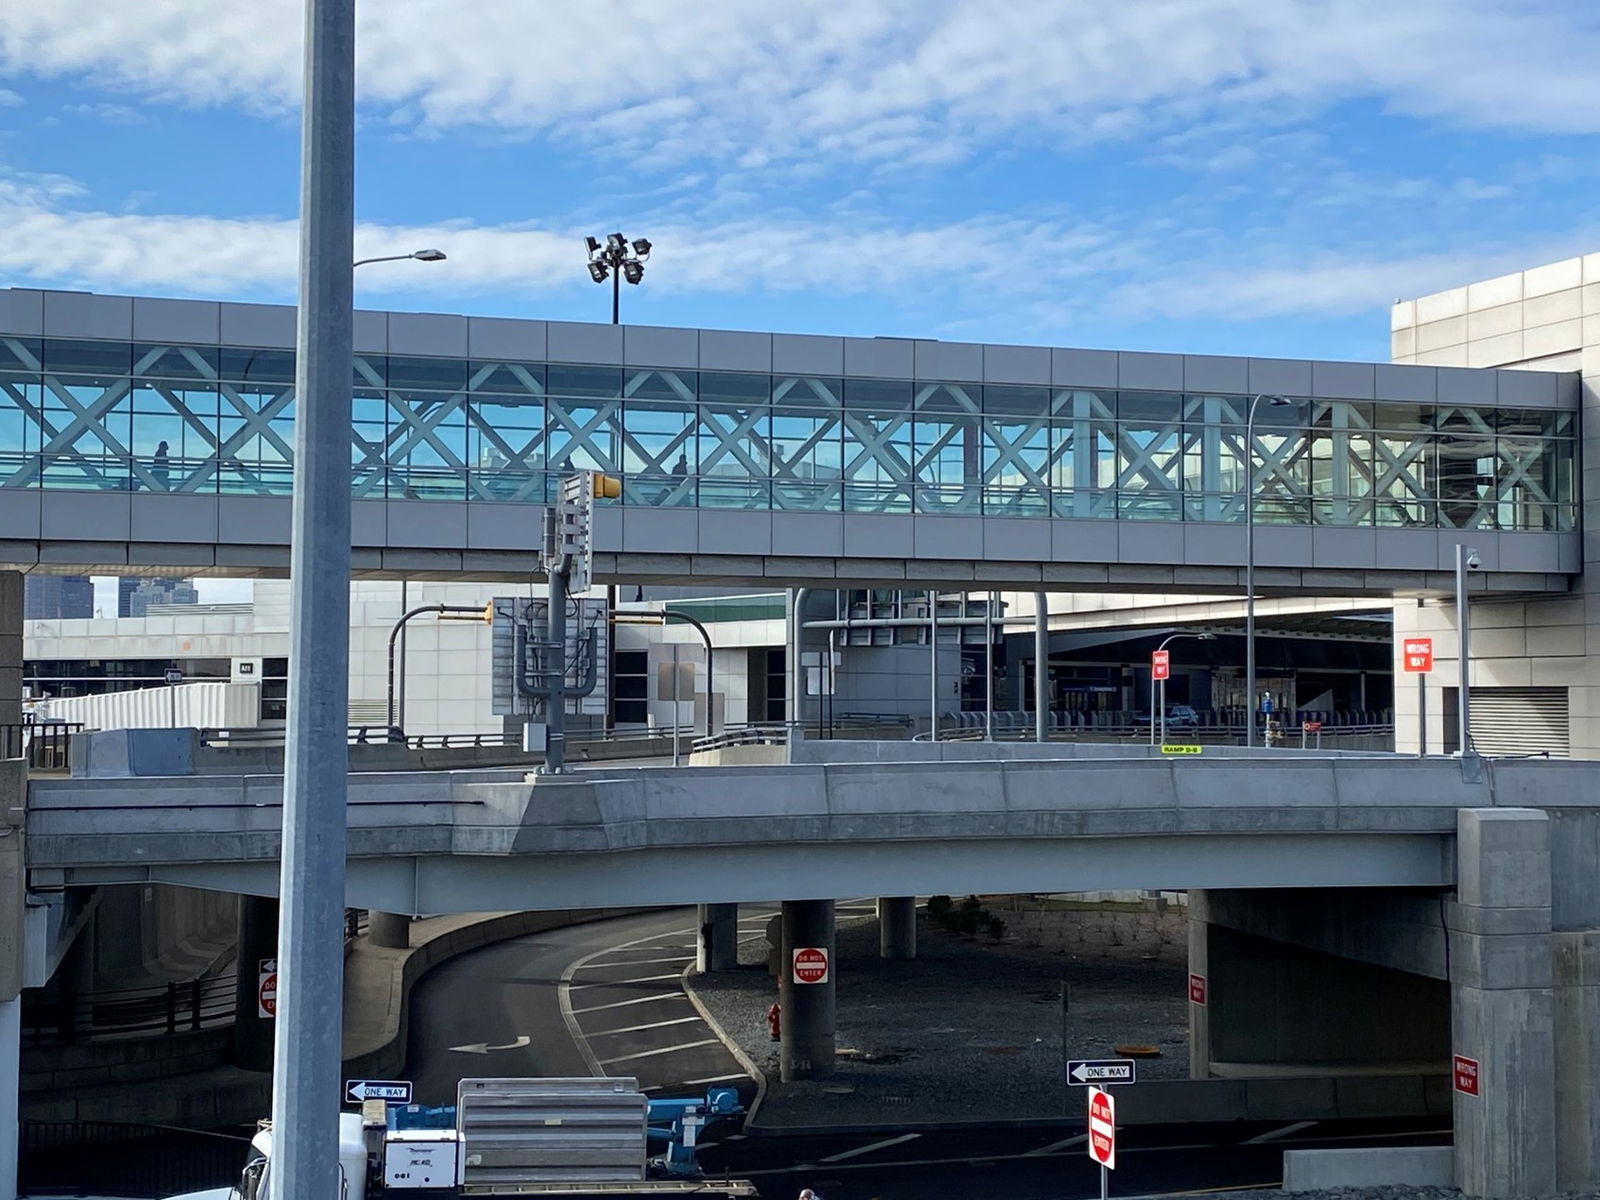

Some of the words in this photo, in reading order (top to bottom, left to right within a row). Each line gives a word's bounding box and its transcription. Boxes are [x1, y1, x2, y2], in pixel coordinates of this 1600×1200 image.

[1407, 644, 1430, 654] WRONG
[1410, 657, 1426, 667] WAY
[264, 981, 276, 990] DO
[1087, 1068, 1105, 1077] ONE
[1108, 1067, 1127, 1076] WAY
[1456, 1061, 1477, 1077] WRONG
[1460, 1076, 1473, 1088] WAY
[364, 1087, 382, 1096] ONE
[386, 1087, 404, 1096] WAY
